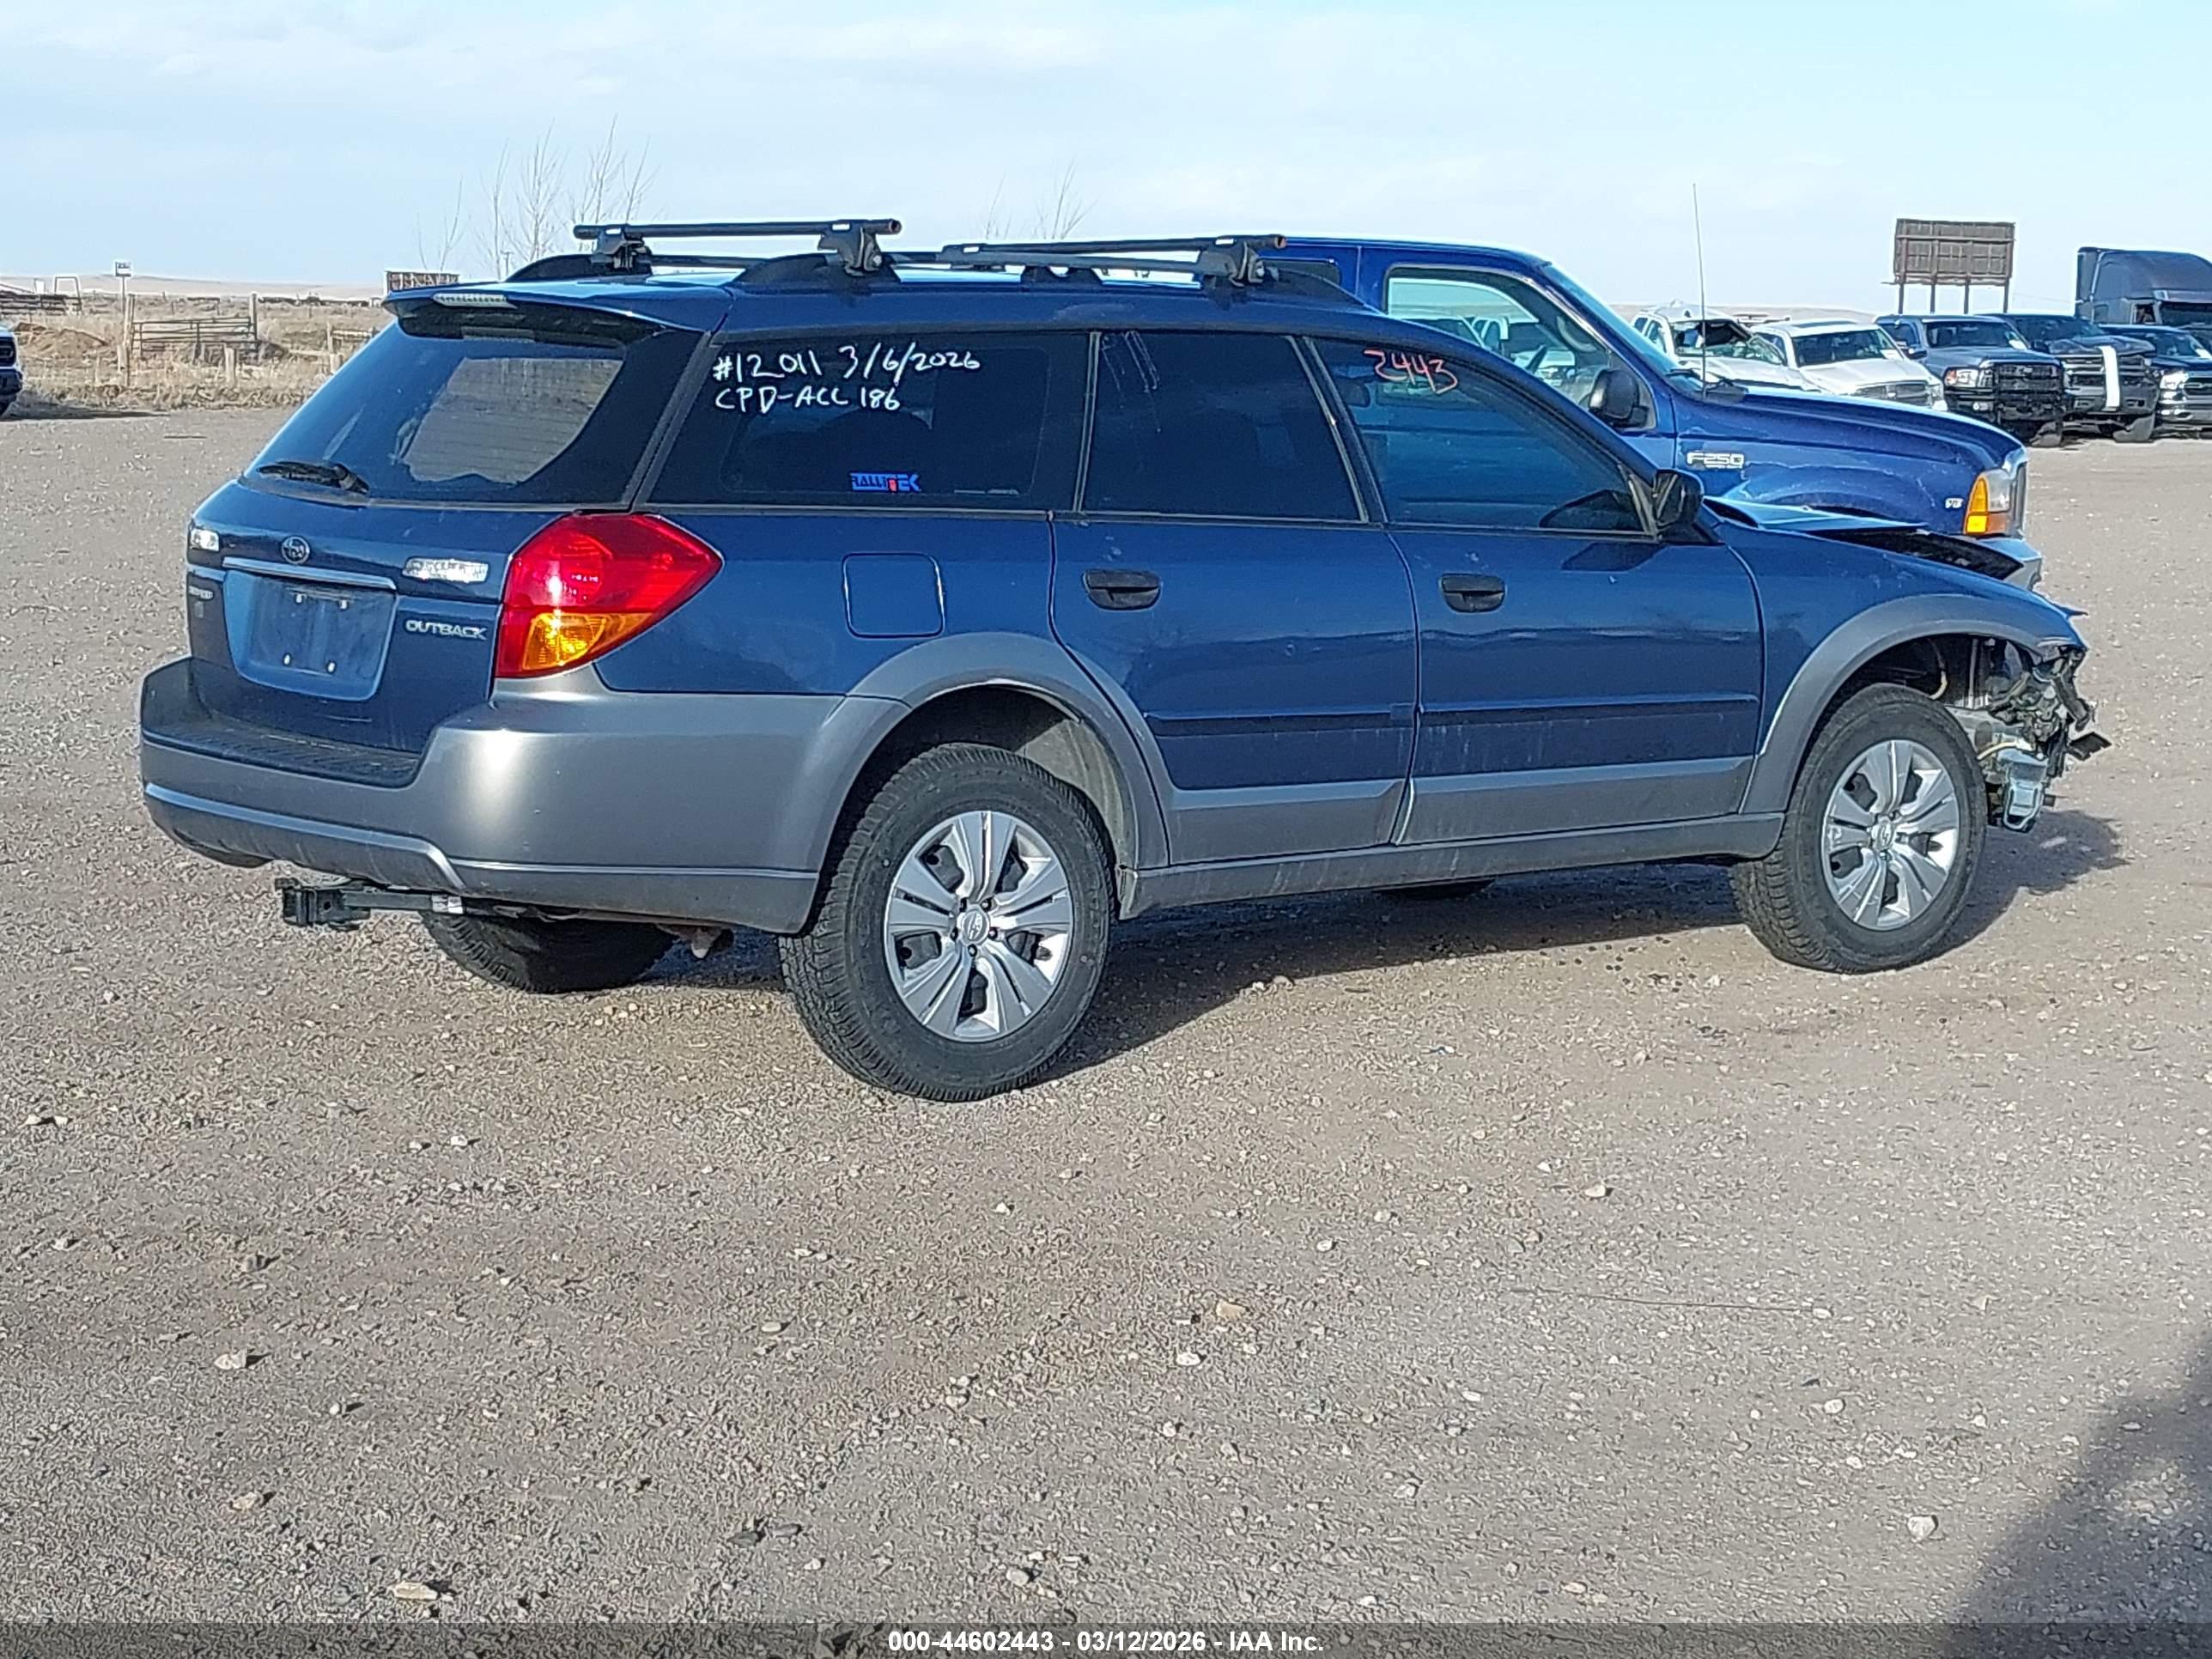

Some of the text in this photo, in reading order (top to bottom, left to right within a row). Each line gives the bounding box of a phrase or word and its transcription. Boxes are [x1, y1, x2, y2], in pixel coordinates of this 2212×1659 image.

[840, 343, 981, 385] 3/6/2026
[1364, 349, 1458, 394] 2443
[714, 385, 901, 413] CPD-ACC 186
[404, 619, 489, 641] OUTBACK
